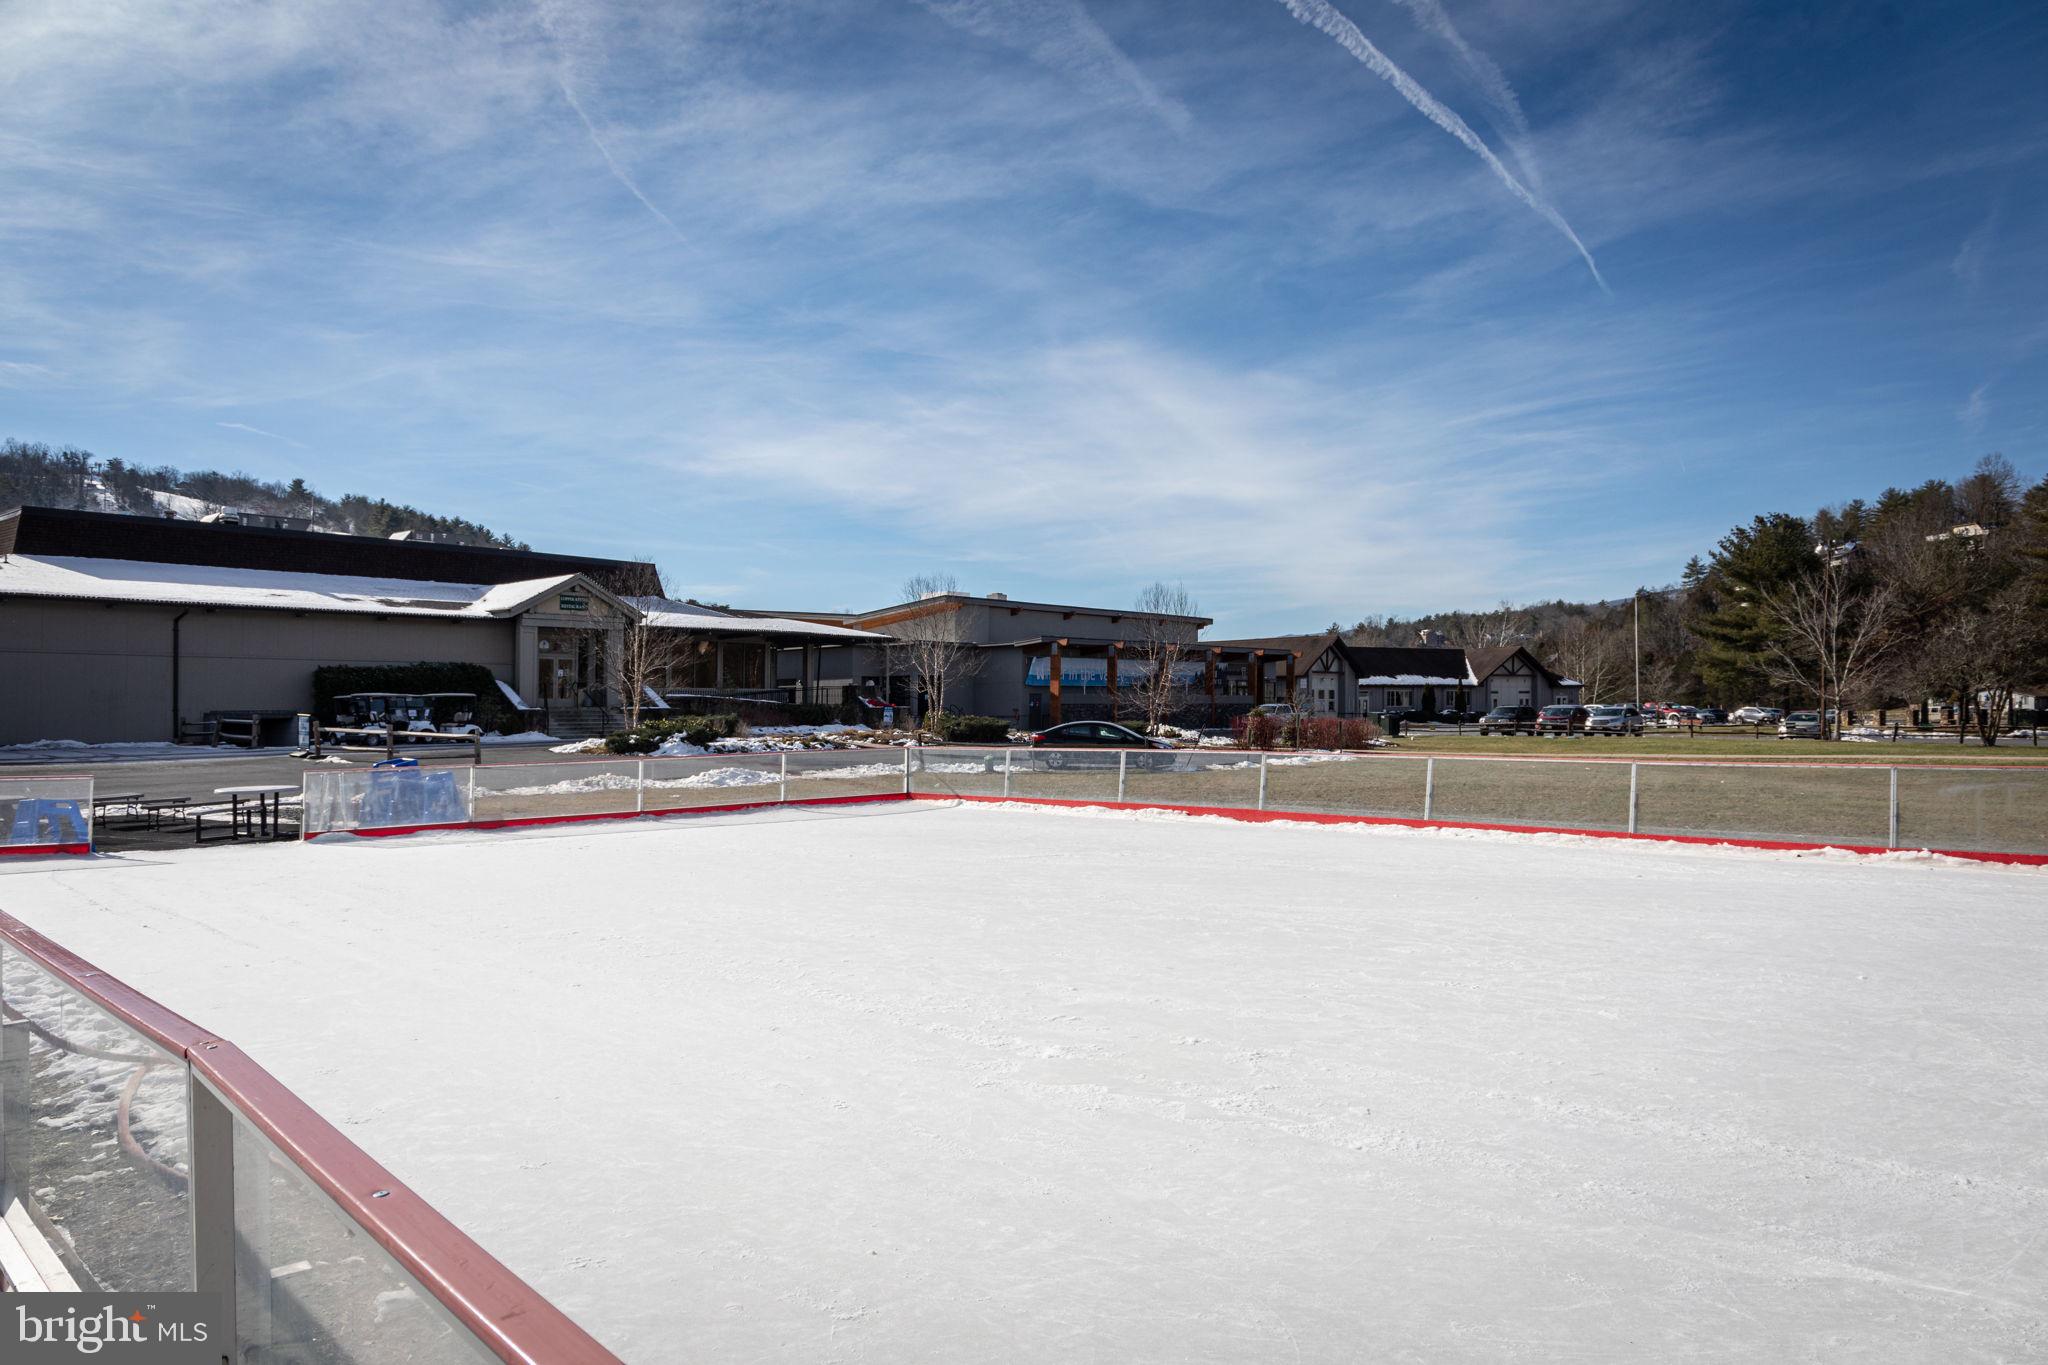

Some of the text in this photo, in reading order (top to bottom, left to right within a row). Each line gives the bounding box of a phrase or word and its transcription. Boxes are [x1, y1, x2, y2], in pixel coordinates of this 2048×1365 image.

[1036, 667, 1125, 684] Wir in the Vaey
